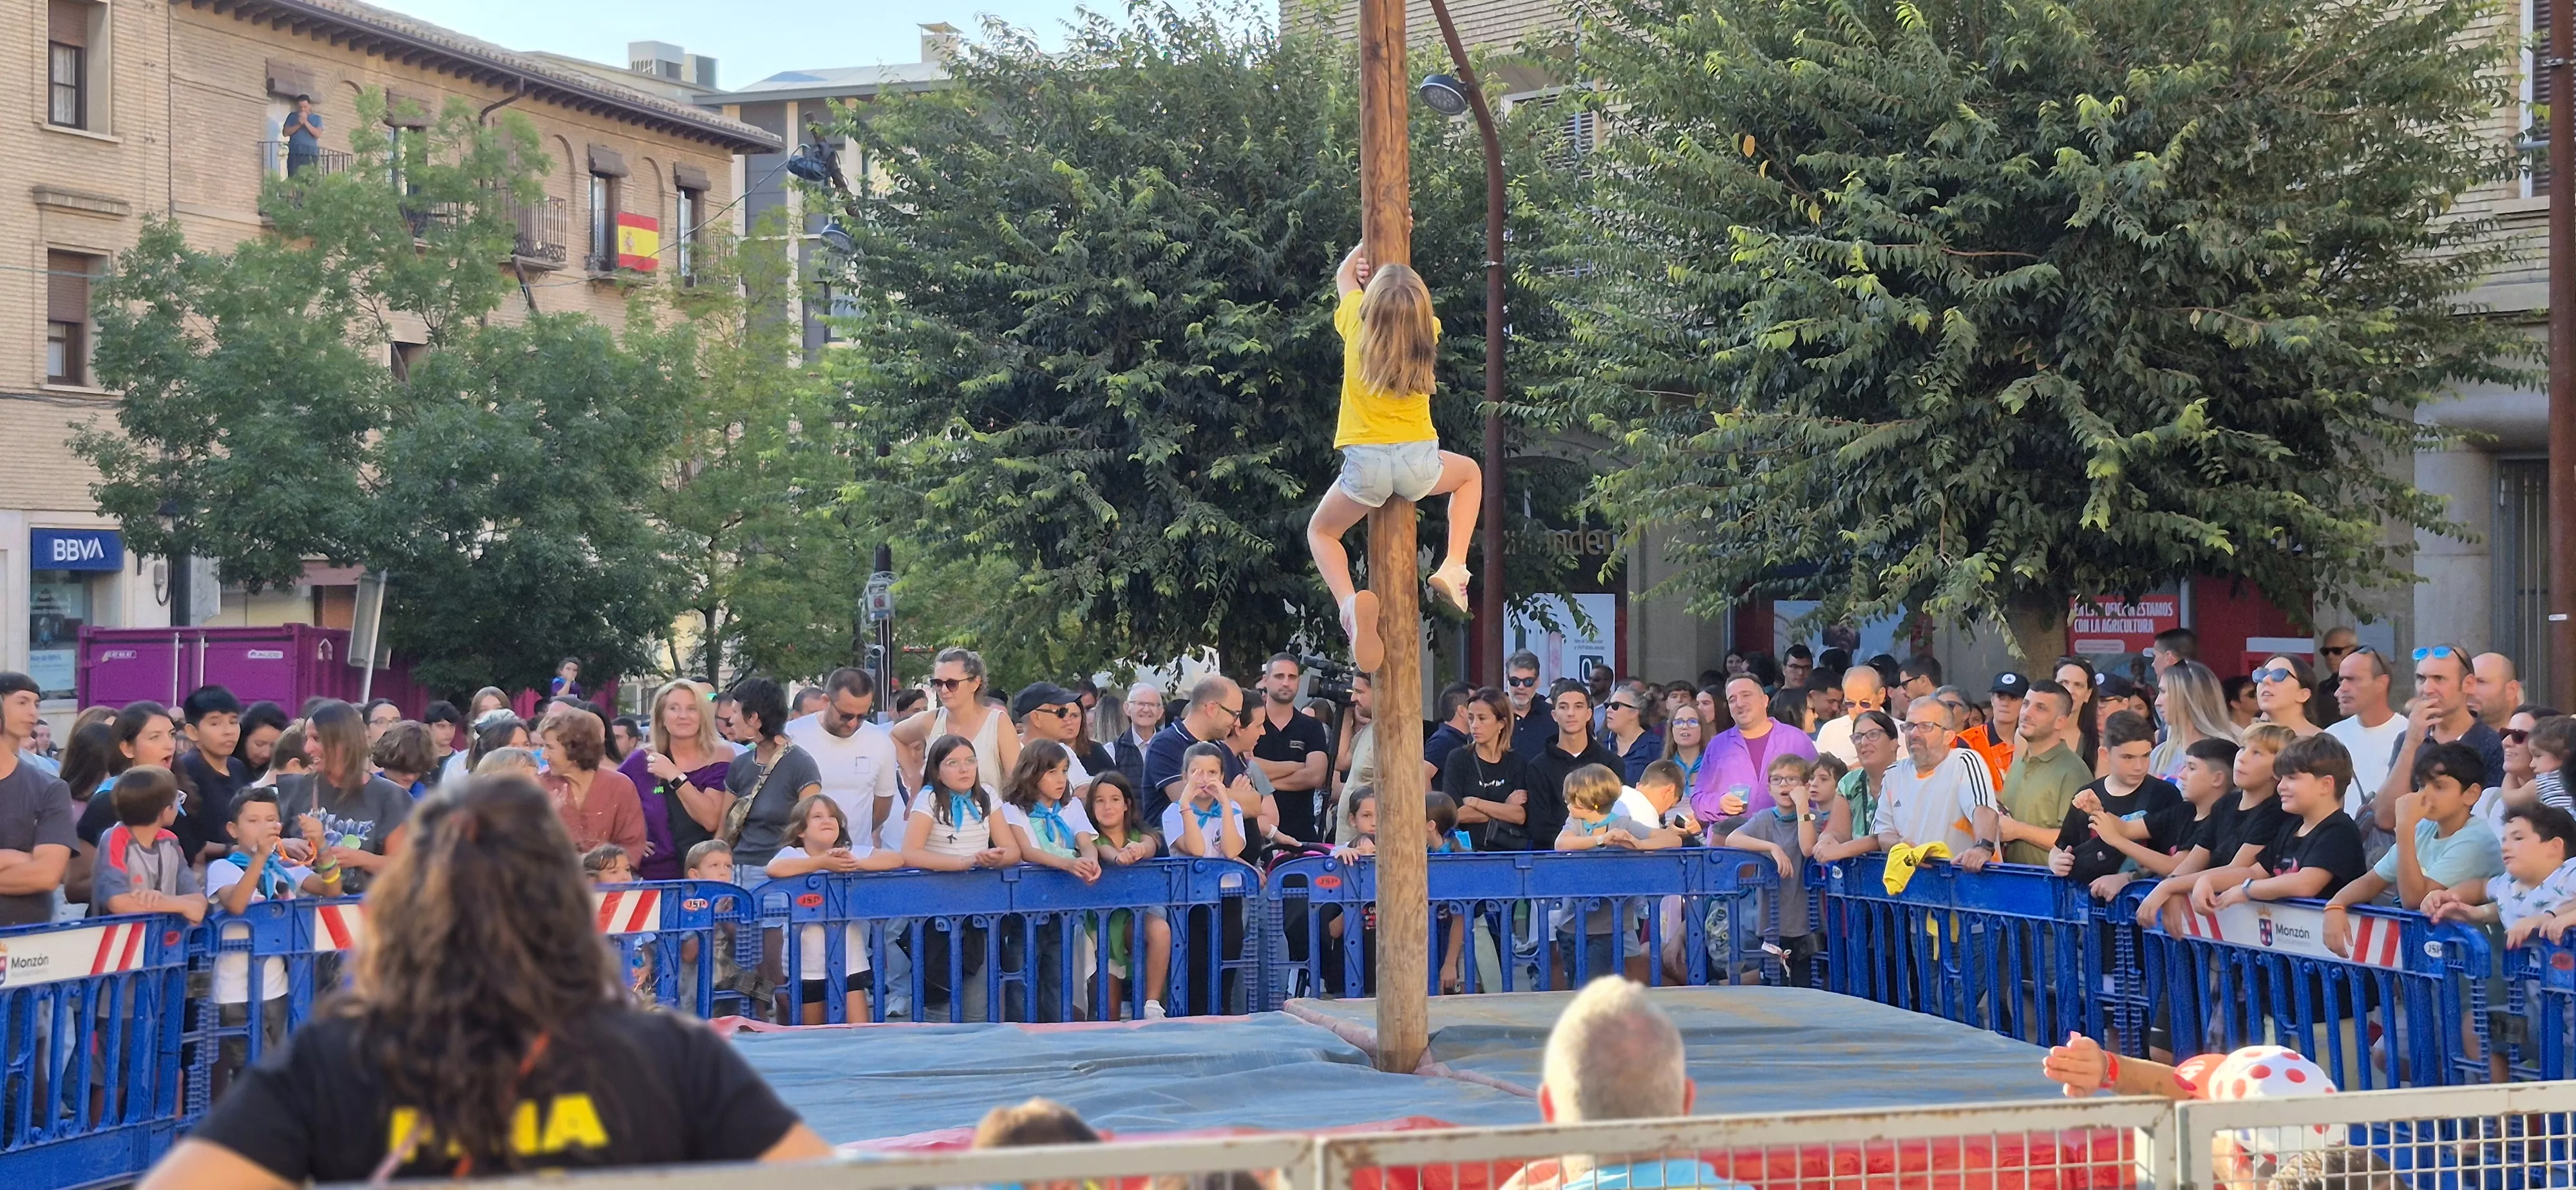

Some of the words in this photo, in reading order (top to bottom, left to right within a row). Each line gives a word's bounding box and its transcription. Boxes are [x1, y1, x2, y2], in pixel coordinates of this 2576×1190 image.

[53, 536, 105, 561] BBVA
[2137, 601, 2174, 616] ESTAMOS
[2074, 619, 2090, 633] CON
[2090, 619, 2101, 633] LA
[2101, 619, 2154, 633] AGRICULTURA
[2275, 923, 2311, 939] Monzón
[10, 953, 49, 970] Monzón
